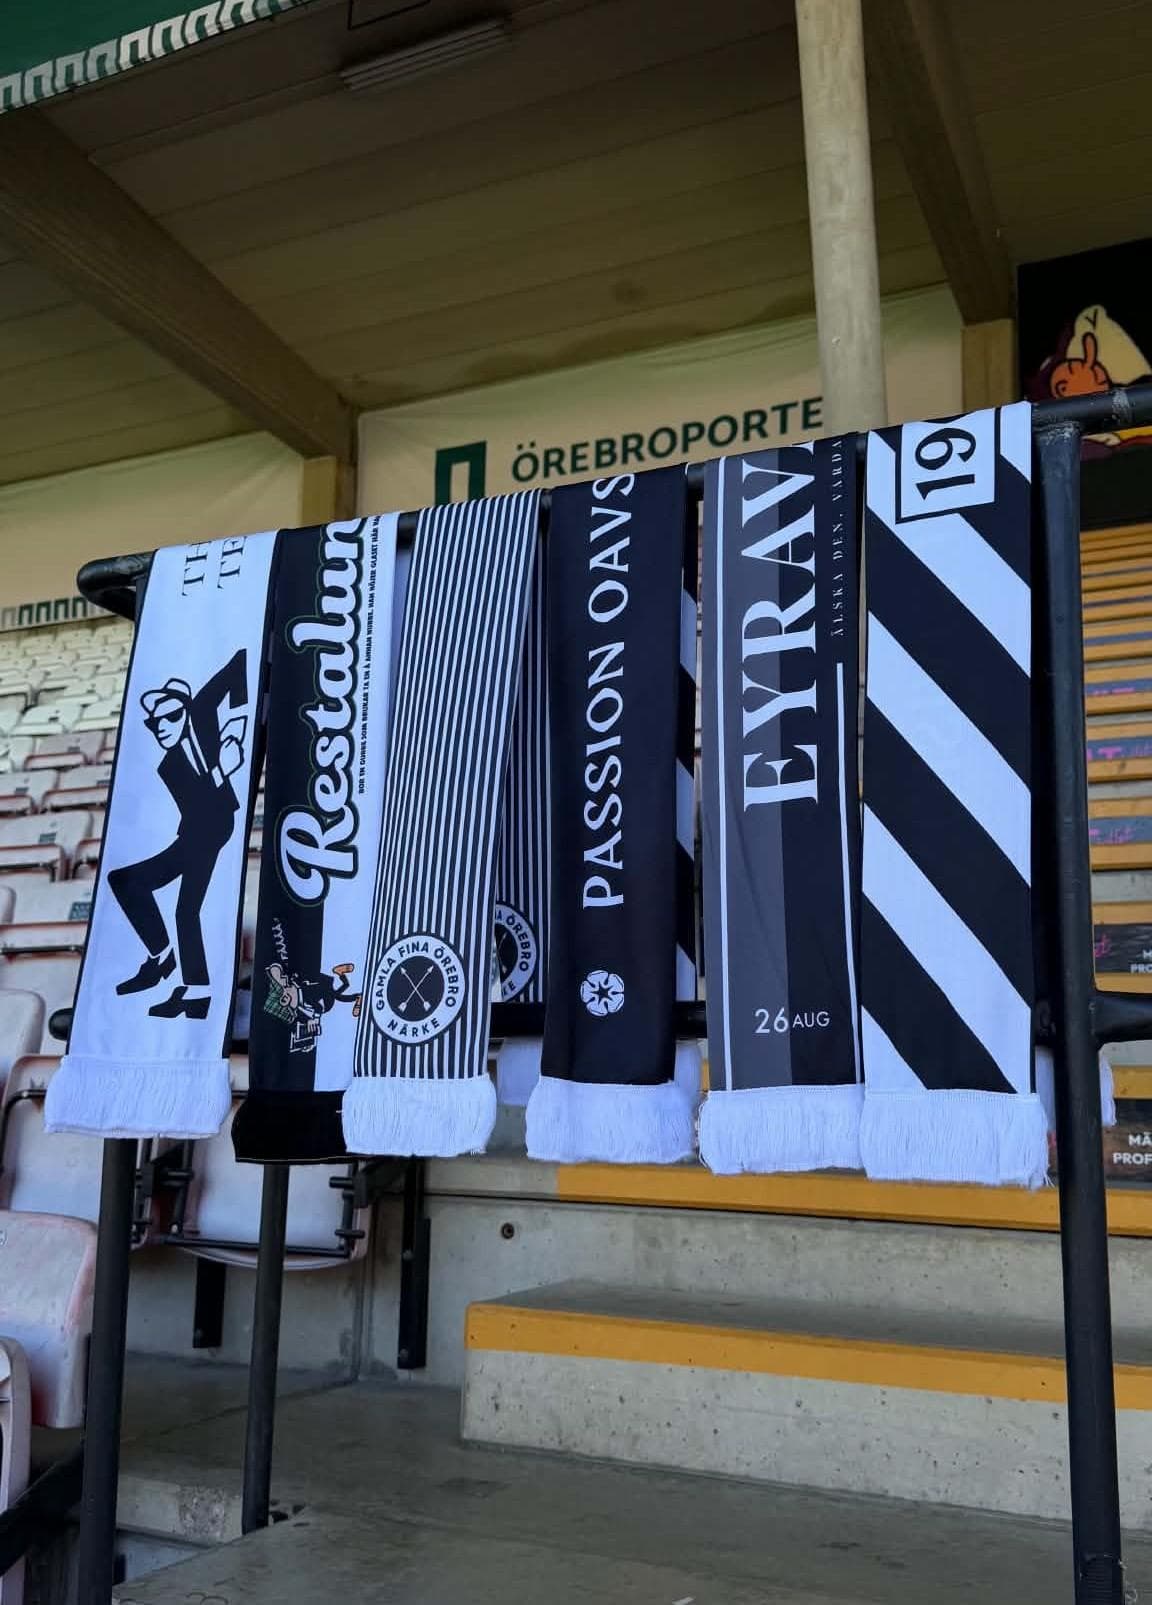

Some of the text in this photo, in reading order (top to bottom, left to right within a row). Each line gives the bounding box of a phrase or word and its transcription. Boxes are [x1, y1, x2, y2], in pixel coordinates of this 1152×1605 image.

[511, 396, 823, 483] ÖREBROPORTE
[915, 414, 977, 501] 19
[741, 440, 818, 812] EYRAV
[582, 473, 635, 909] PASSION OAVS
[397, 941, 430, 958] FINA
[433, 945, 460, 1008] ÖREBRO
[375, 956, 396, 1011] GAMLA
[387, 1017, 440, 1037] NÄRKE
[754, 1007, 830, 1034] 26 AUG
